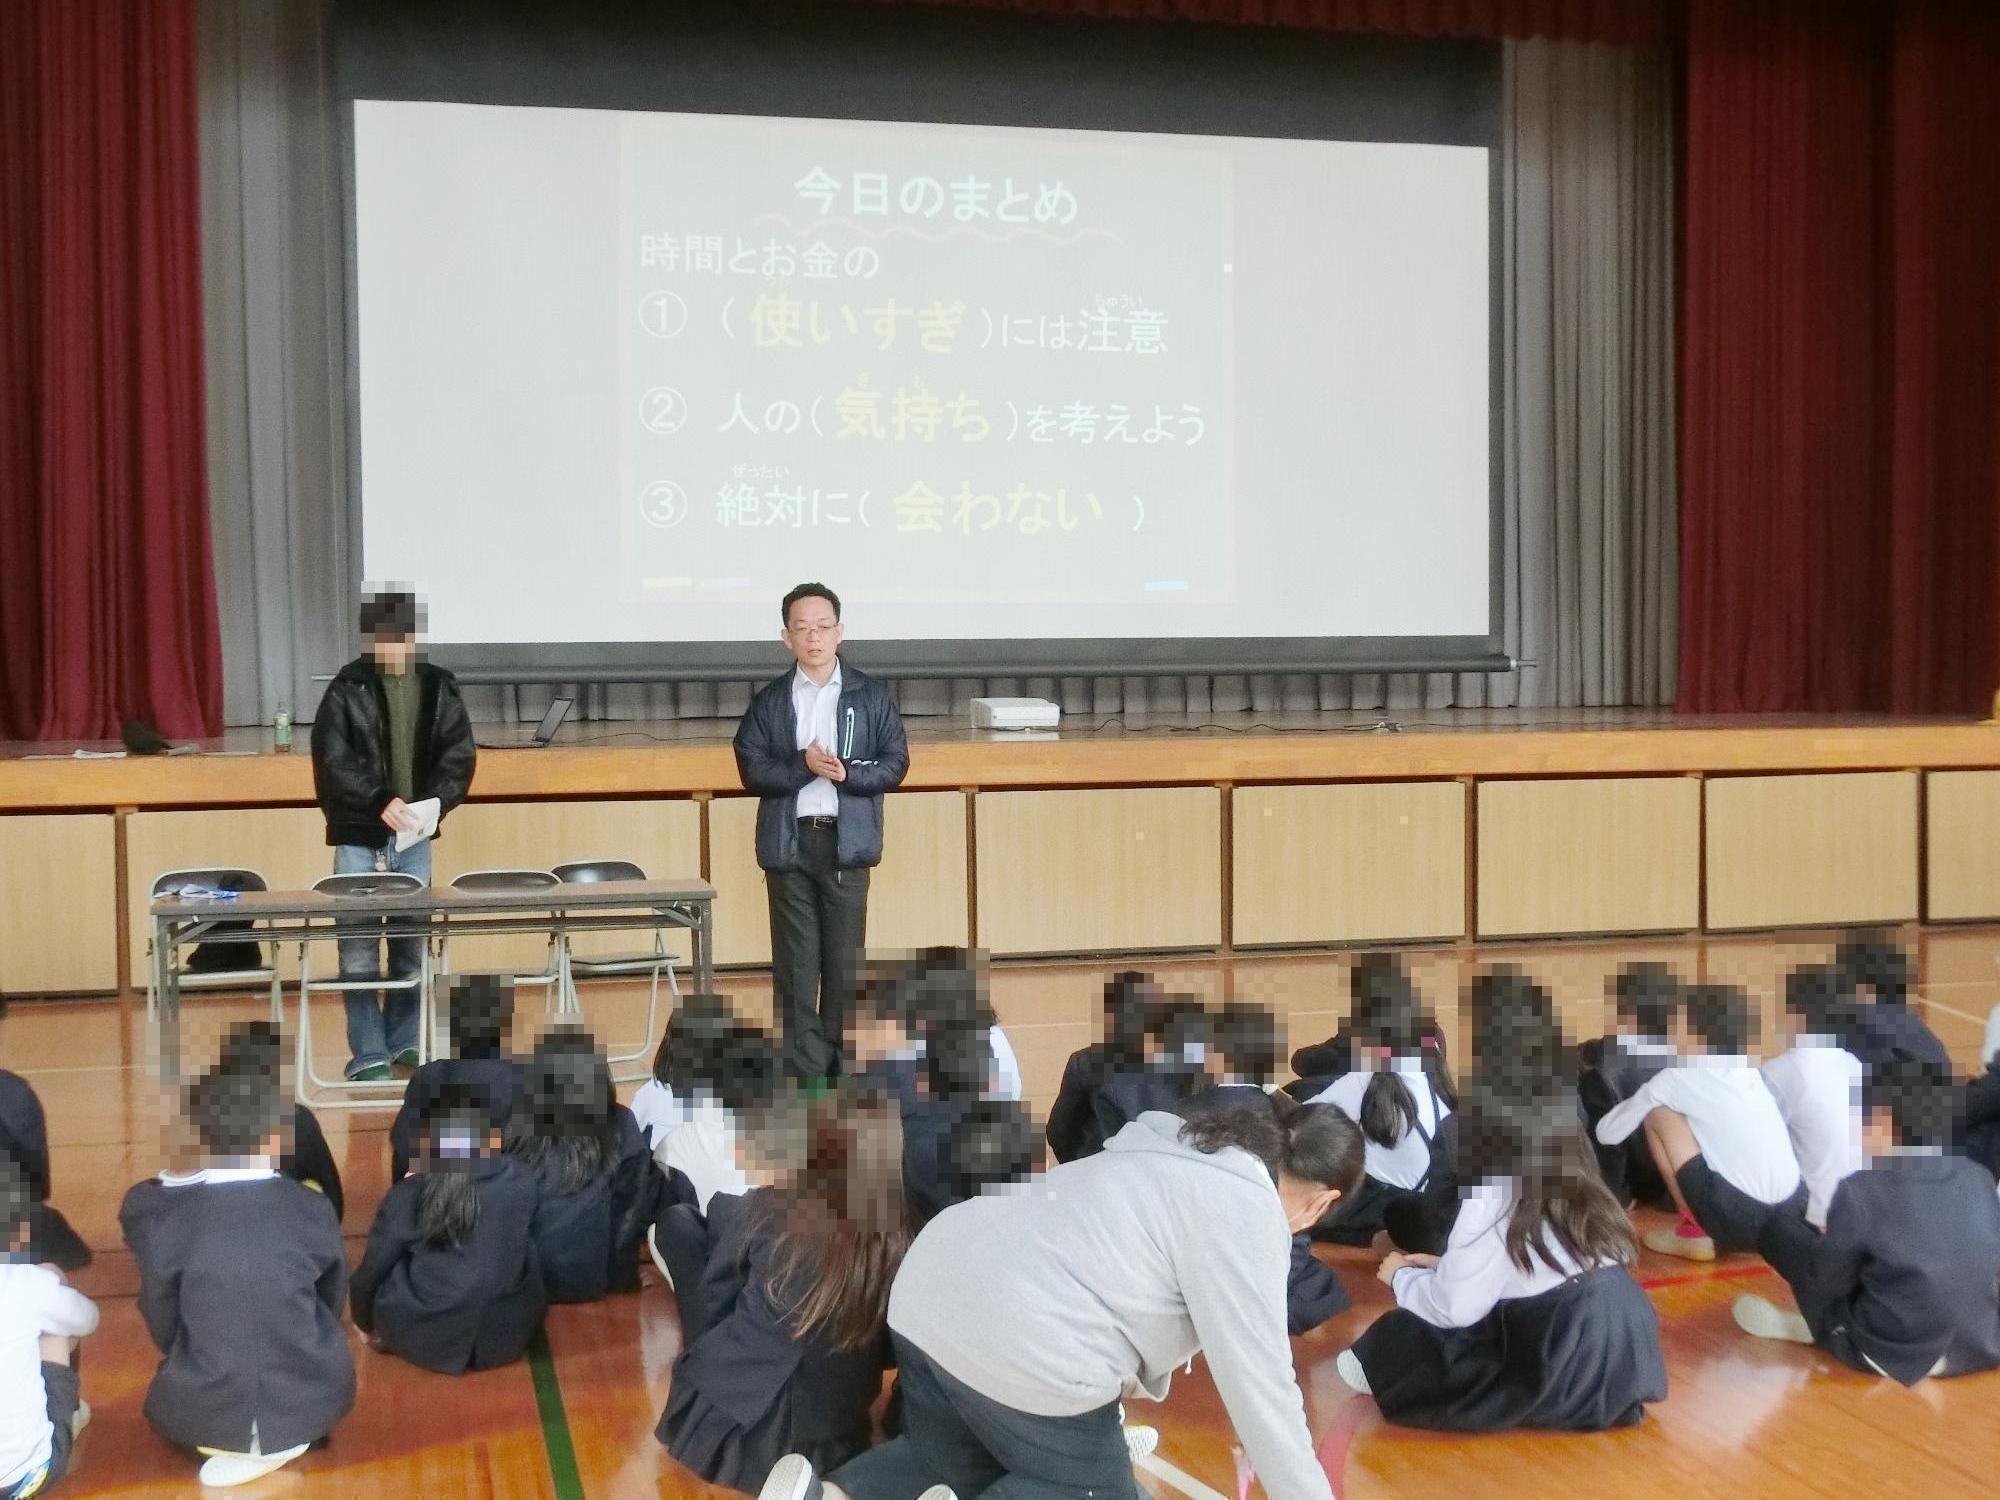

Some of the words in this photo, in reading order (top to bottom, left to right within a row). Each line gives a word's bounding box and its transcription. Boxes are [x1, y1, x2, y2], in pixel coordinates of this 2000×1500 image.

[794, 165, 1078, 225] 今日のまとめ
[640, 232, 880, 280] 時間とお金の
[732, 463, 790, 479] ぜったい
